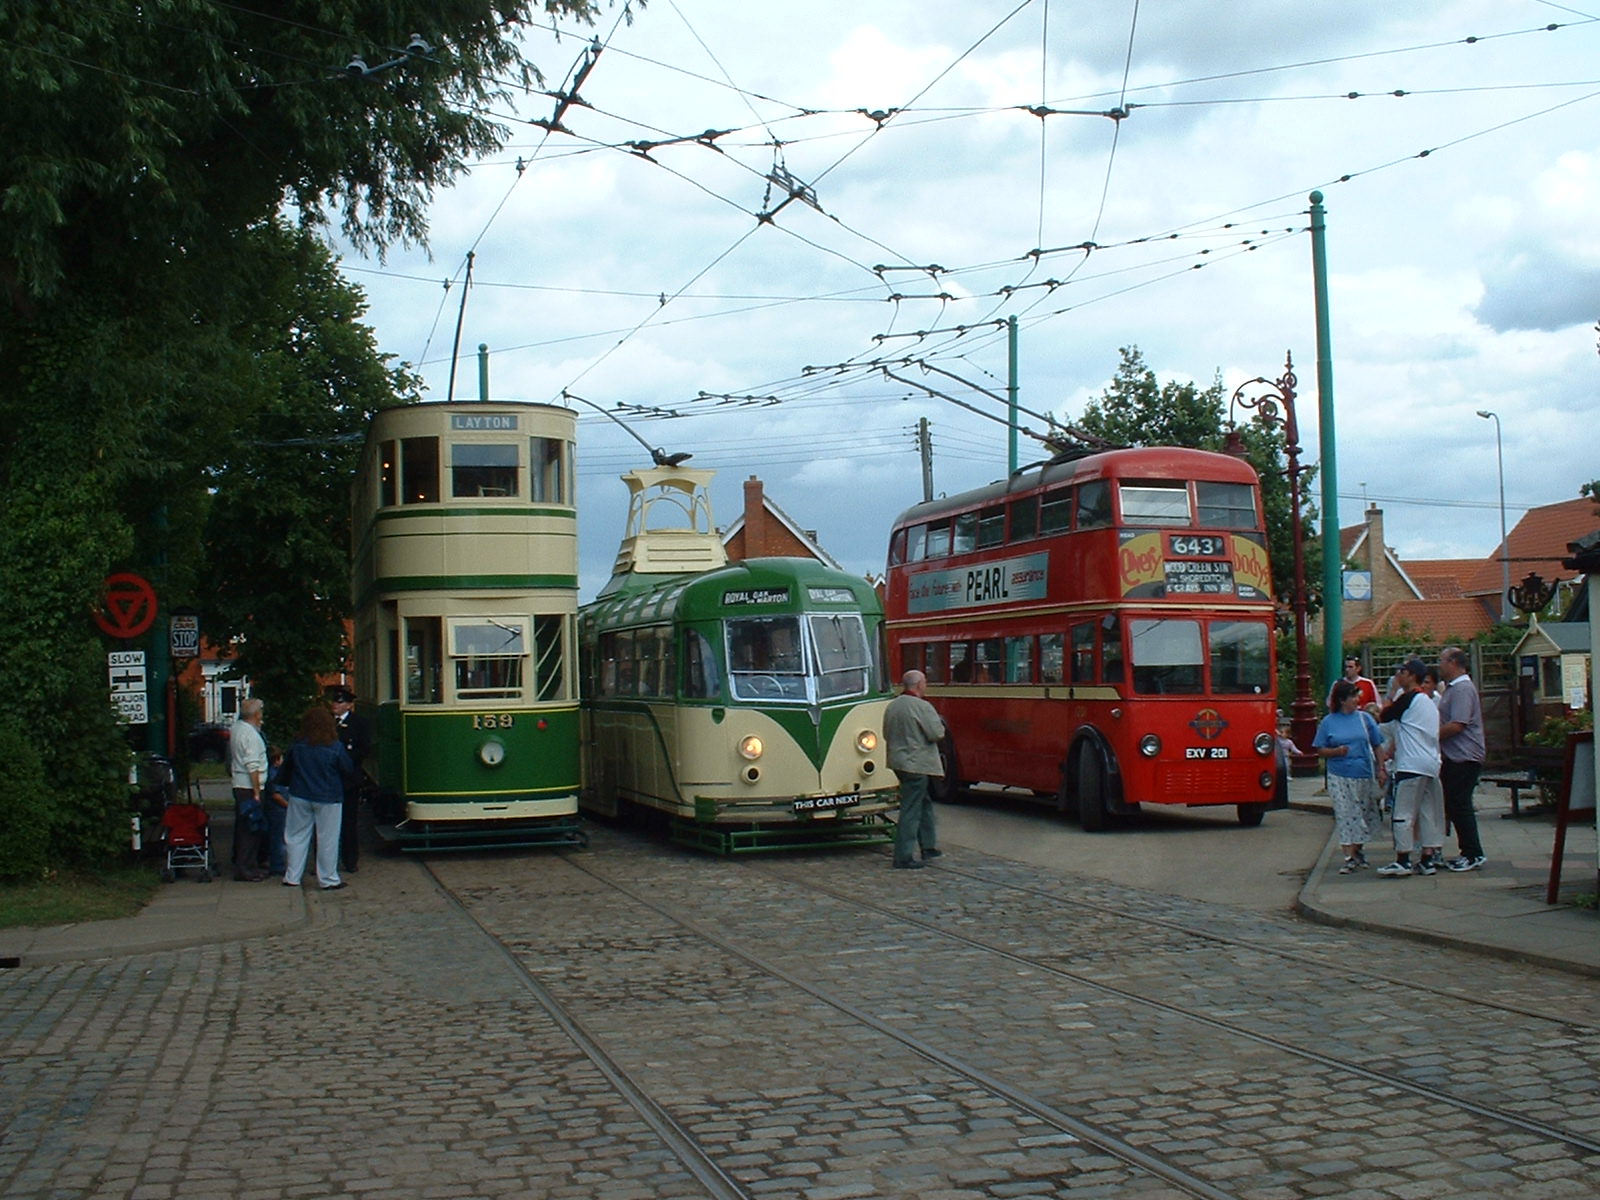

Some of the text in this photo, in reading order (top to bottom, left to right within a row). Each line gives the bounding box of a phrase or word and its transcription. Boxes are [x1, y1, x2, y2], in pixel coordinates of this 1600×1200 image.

[455, 416, 511, 428] LAYTON
[1174, 538, 1214, 554] 643
[967, 566, 1008, 602] PEARL
[724, 592, 749, 604] ROYAL
[173, 631, 197, 647] STOP
[111, 654, 143, 664] SLOW
[112, 694, 145, 702] MAJOR
[119, 704, 142, 712] OAD
[473, 713, 514, 730] 159
[1186, 748, 1228, 758] EXV 201
[794, 794, 859, 810] THIS CAR NEXT
